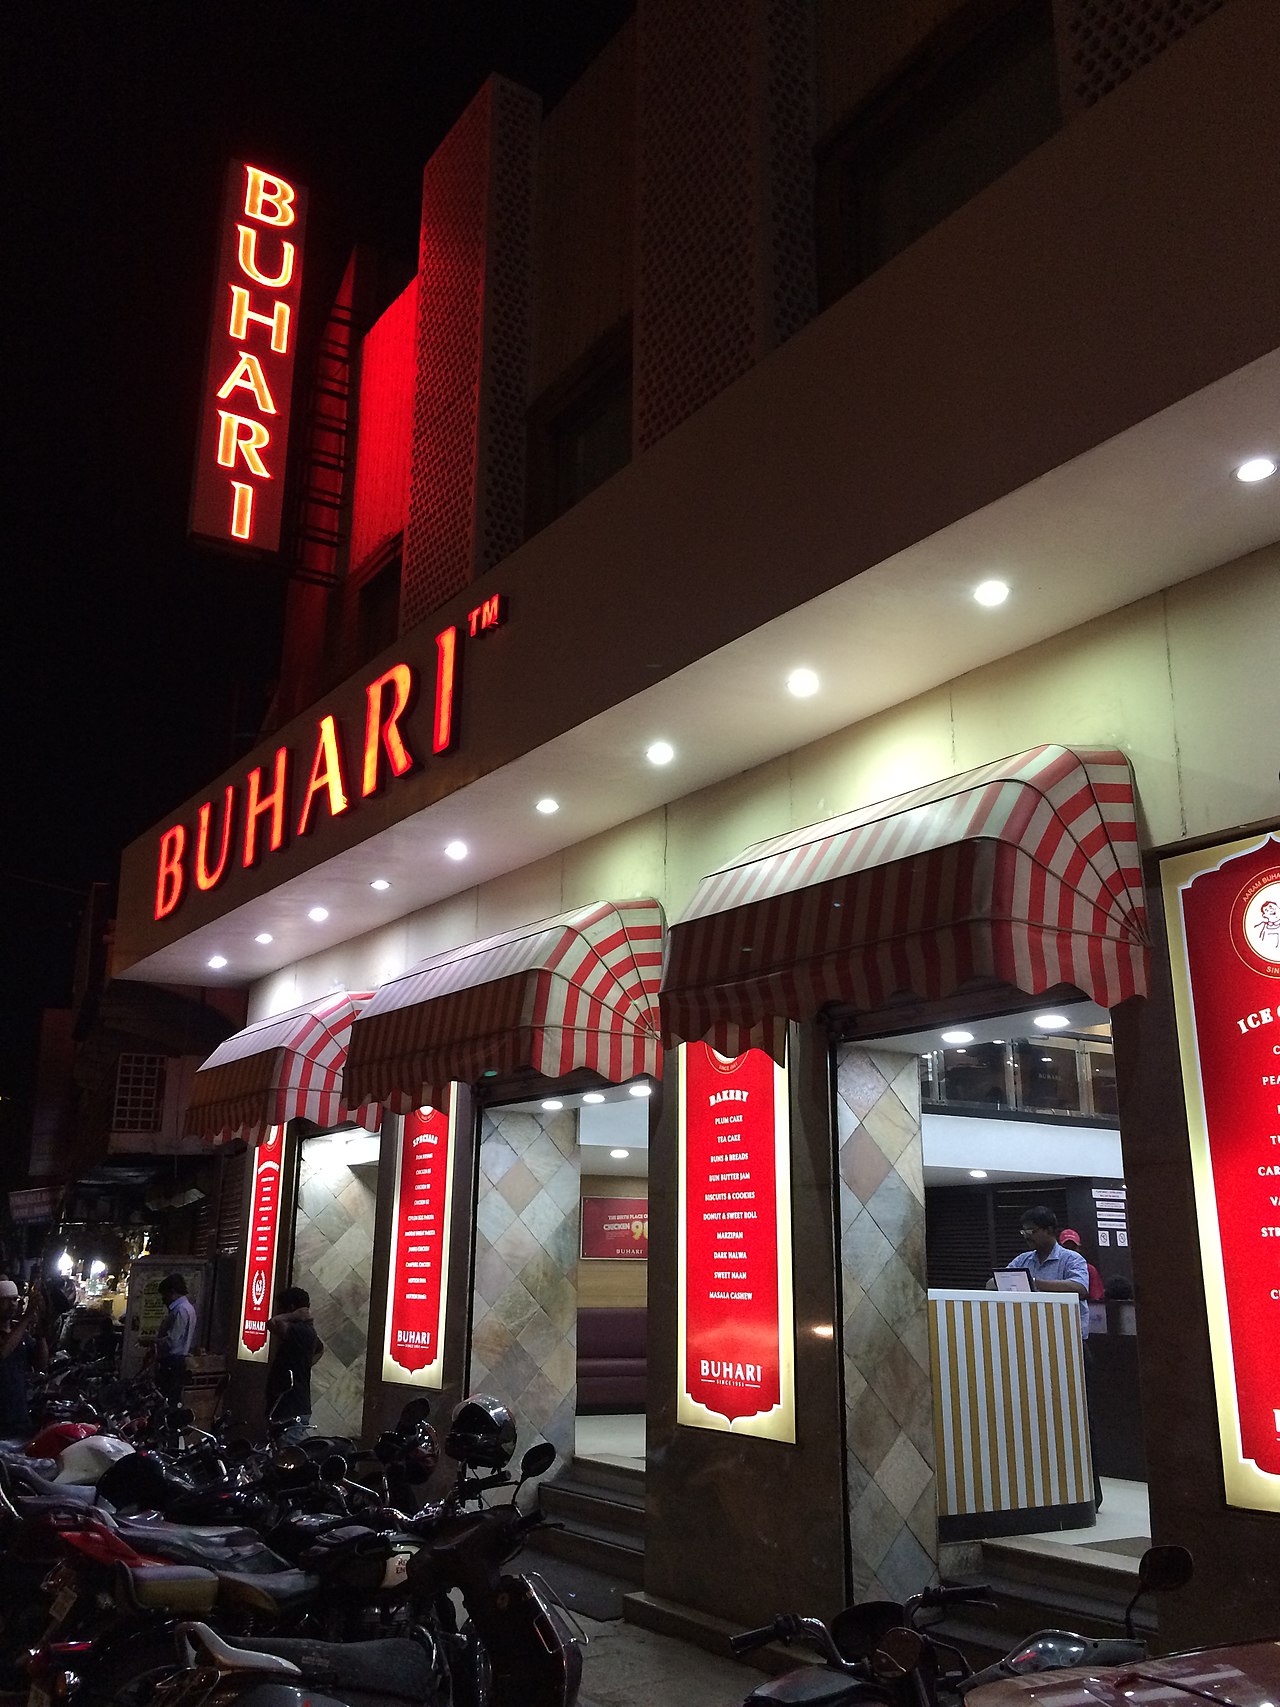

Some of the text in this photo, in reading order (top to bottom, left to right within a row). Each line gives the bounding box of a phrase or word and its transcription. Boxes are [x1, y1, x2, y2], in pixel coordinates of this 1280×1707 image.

[215, 164, 296, 540] BUHARI
[154, 593, 499, 921] BUHARI TM
[1237, 1008, 1274, 1034] ICE
[709, 1090, 749, 1106] BAKERY
[715, 1115, 743, 1125] PLUM CAKE
[728, 1134, 741, 1142] CAKE
[729, 1153, 749, 1161] BREADS
[720, 1173, 739, 1181] BUTTER
[740, 1172, 750, 1180] JAM
[705, 1193, 726, 1201] BISCUITS
[732, 1191, 755, 1199] COOKIES
[728, 1251, 747, 1259] HALWA
[714, 1271, 730, 1279] SWEET
[709, 1291, 729, 1299] MASALA
[397, 1329, 431, 1345] BUHARI
[700, 1359, 761, 1382] BUHARI
